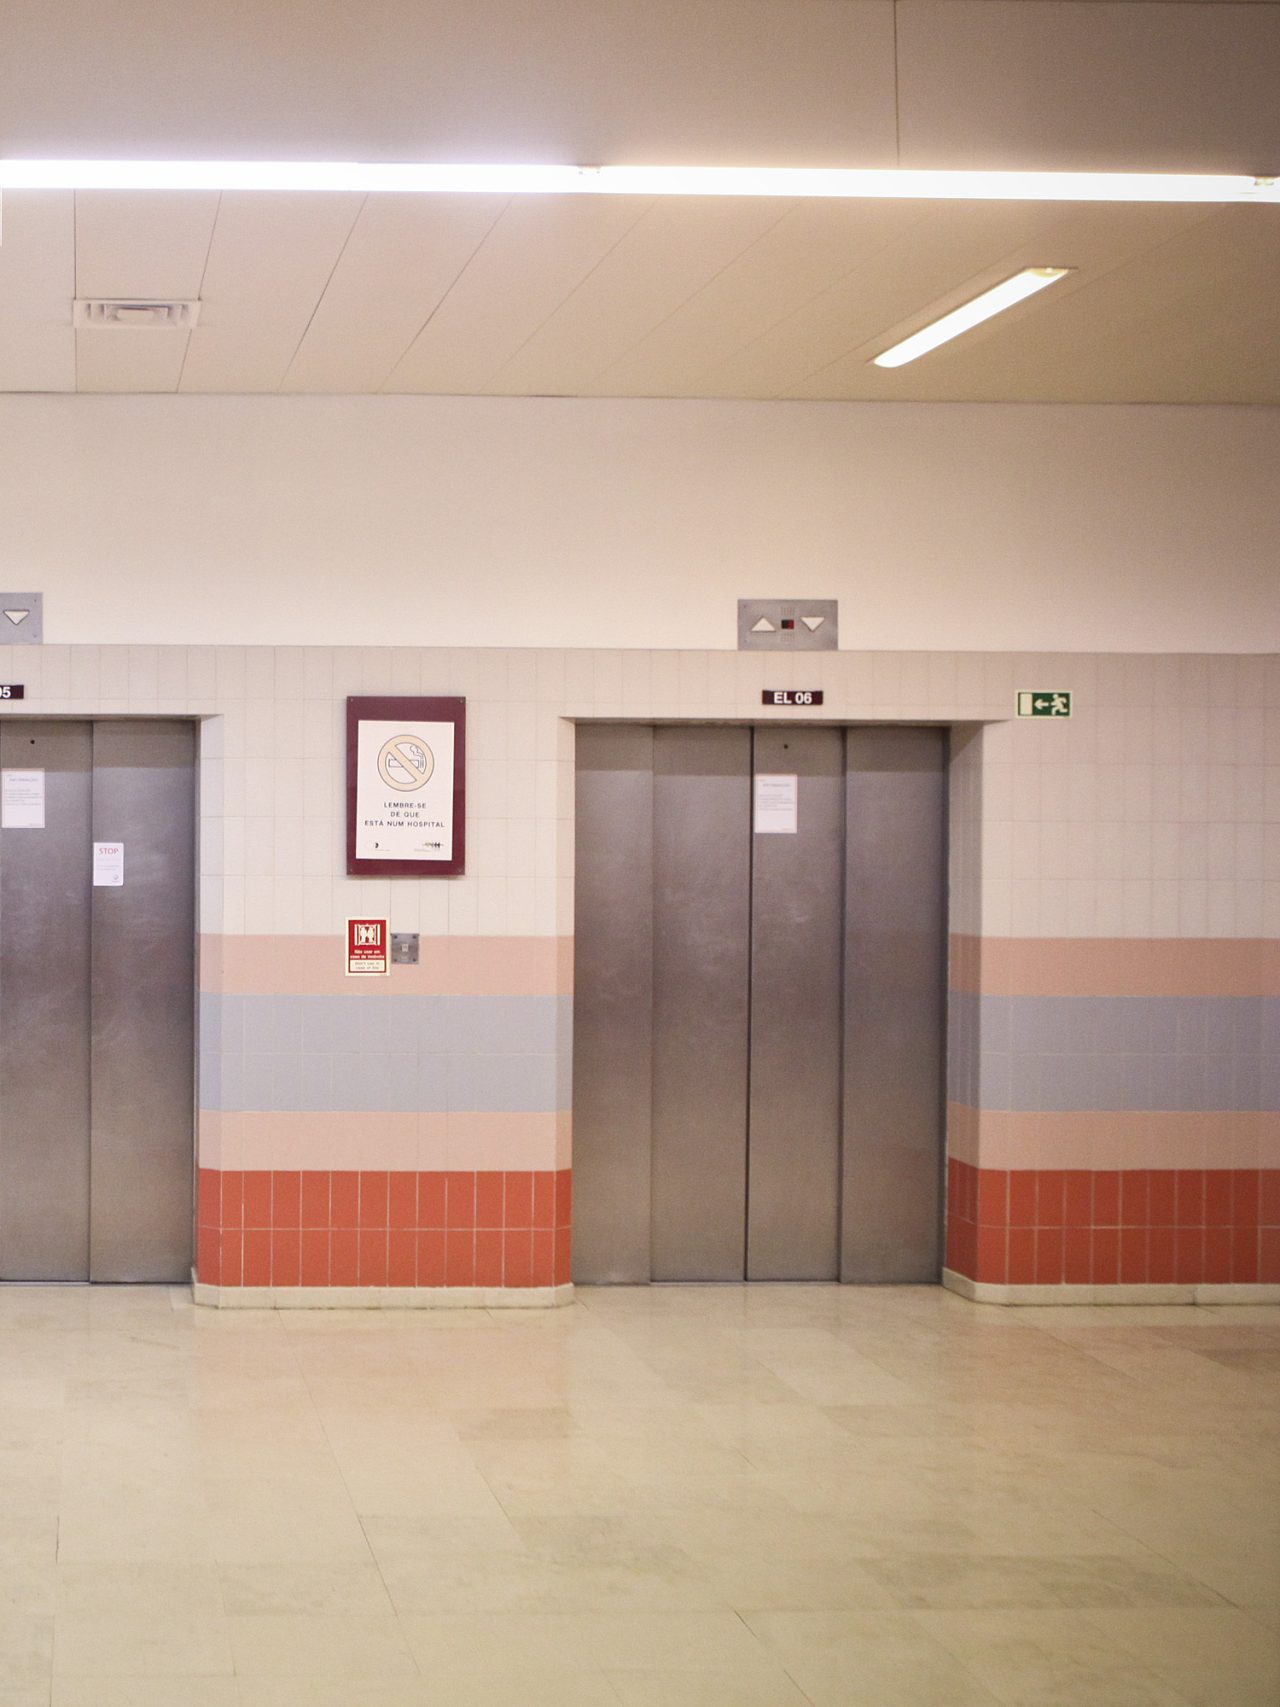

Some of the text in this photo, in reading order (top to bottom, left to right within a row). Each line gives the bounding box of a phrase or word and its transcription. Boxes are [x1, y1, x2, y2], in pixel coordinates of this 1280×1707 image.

[774, 692, 812, 704] EL 06
[364, 819, 384, 827] ESTÁ
[99, 847, 119, 855] STOP
